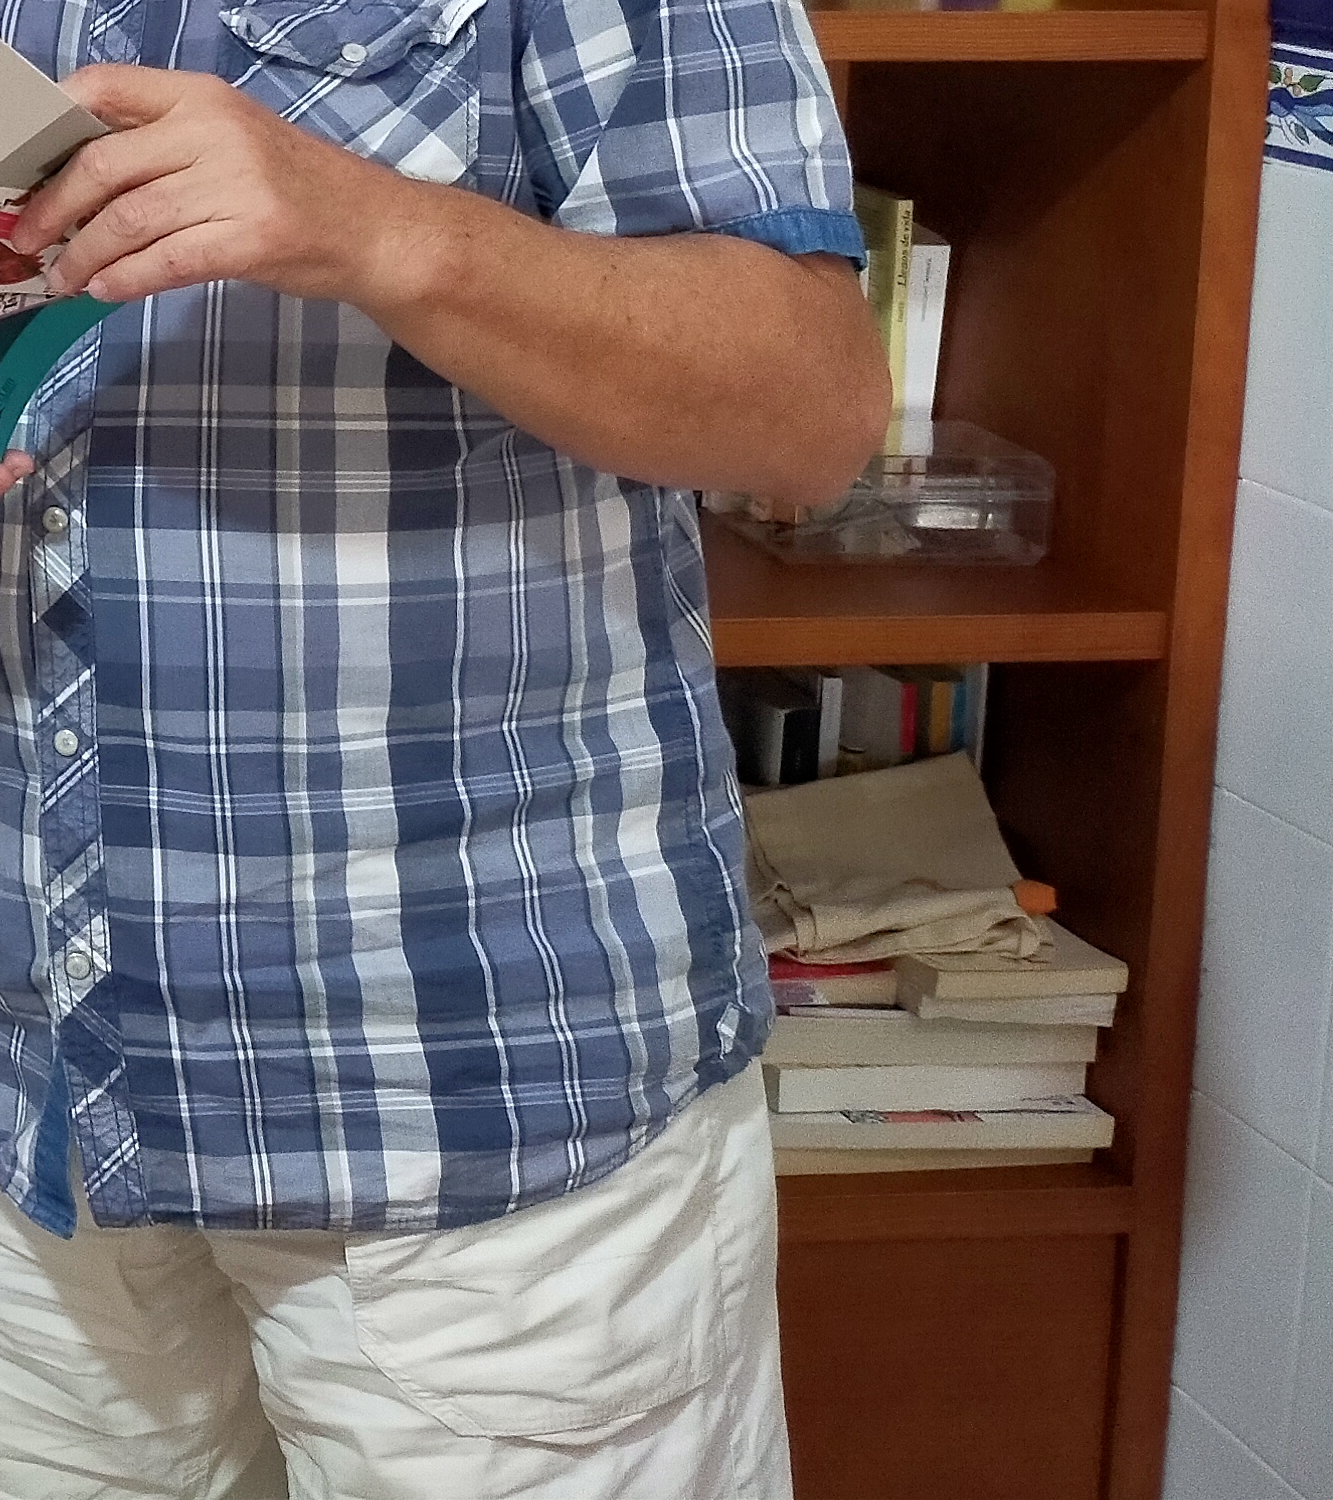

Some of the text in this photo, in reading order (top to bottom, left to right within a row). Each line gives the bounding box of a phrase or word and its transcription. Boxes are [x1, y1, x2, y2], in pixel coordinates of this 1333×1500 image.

[896, 209, 912, 288] Llenos de vida
